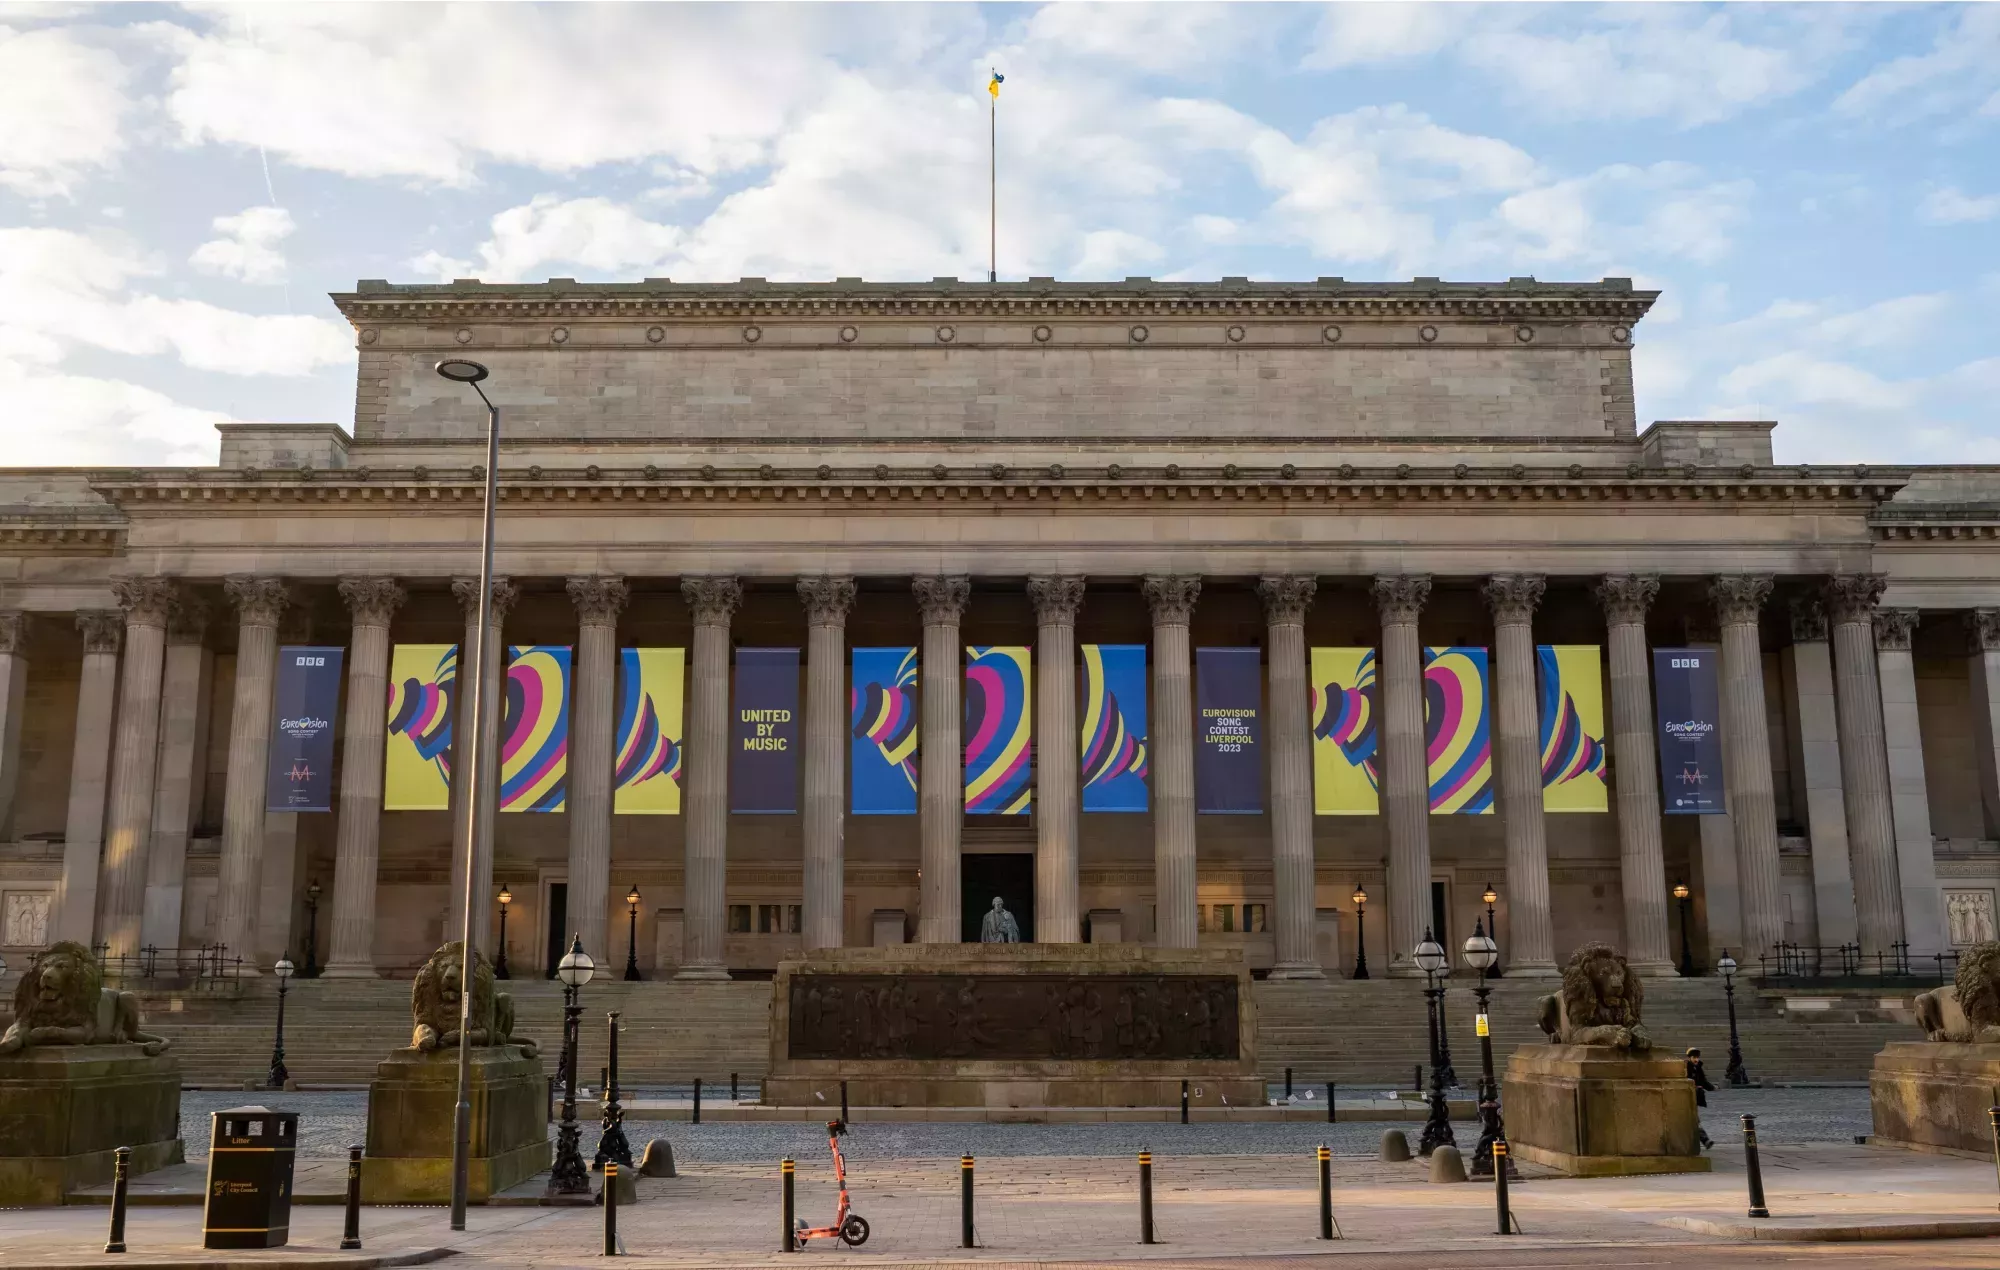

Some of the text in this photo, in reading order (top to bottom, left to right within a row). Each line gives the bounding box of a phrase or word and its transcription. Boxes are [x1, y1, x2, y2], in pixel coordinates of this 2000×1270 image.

[297, 658, 324, 666] BBC
[742, 710, 790, 722] UNITED
[1203, 709, 1255, 717] EUROVISION
[1217, 718, 1242, 726] SONG
[757, 724, 774, 736] BY
[1206, 735, 1253, 743] LIVERPOOL
[744, 738, 787, 750] MUSIC
[1218, 744, 1241, 752] 2023
